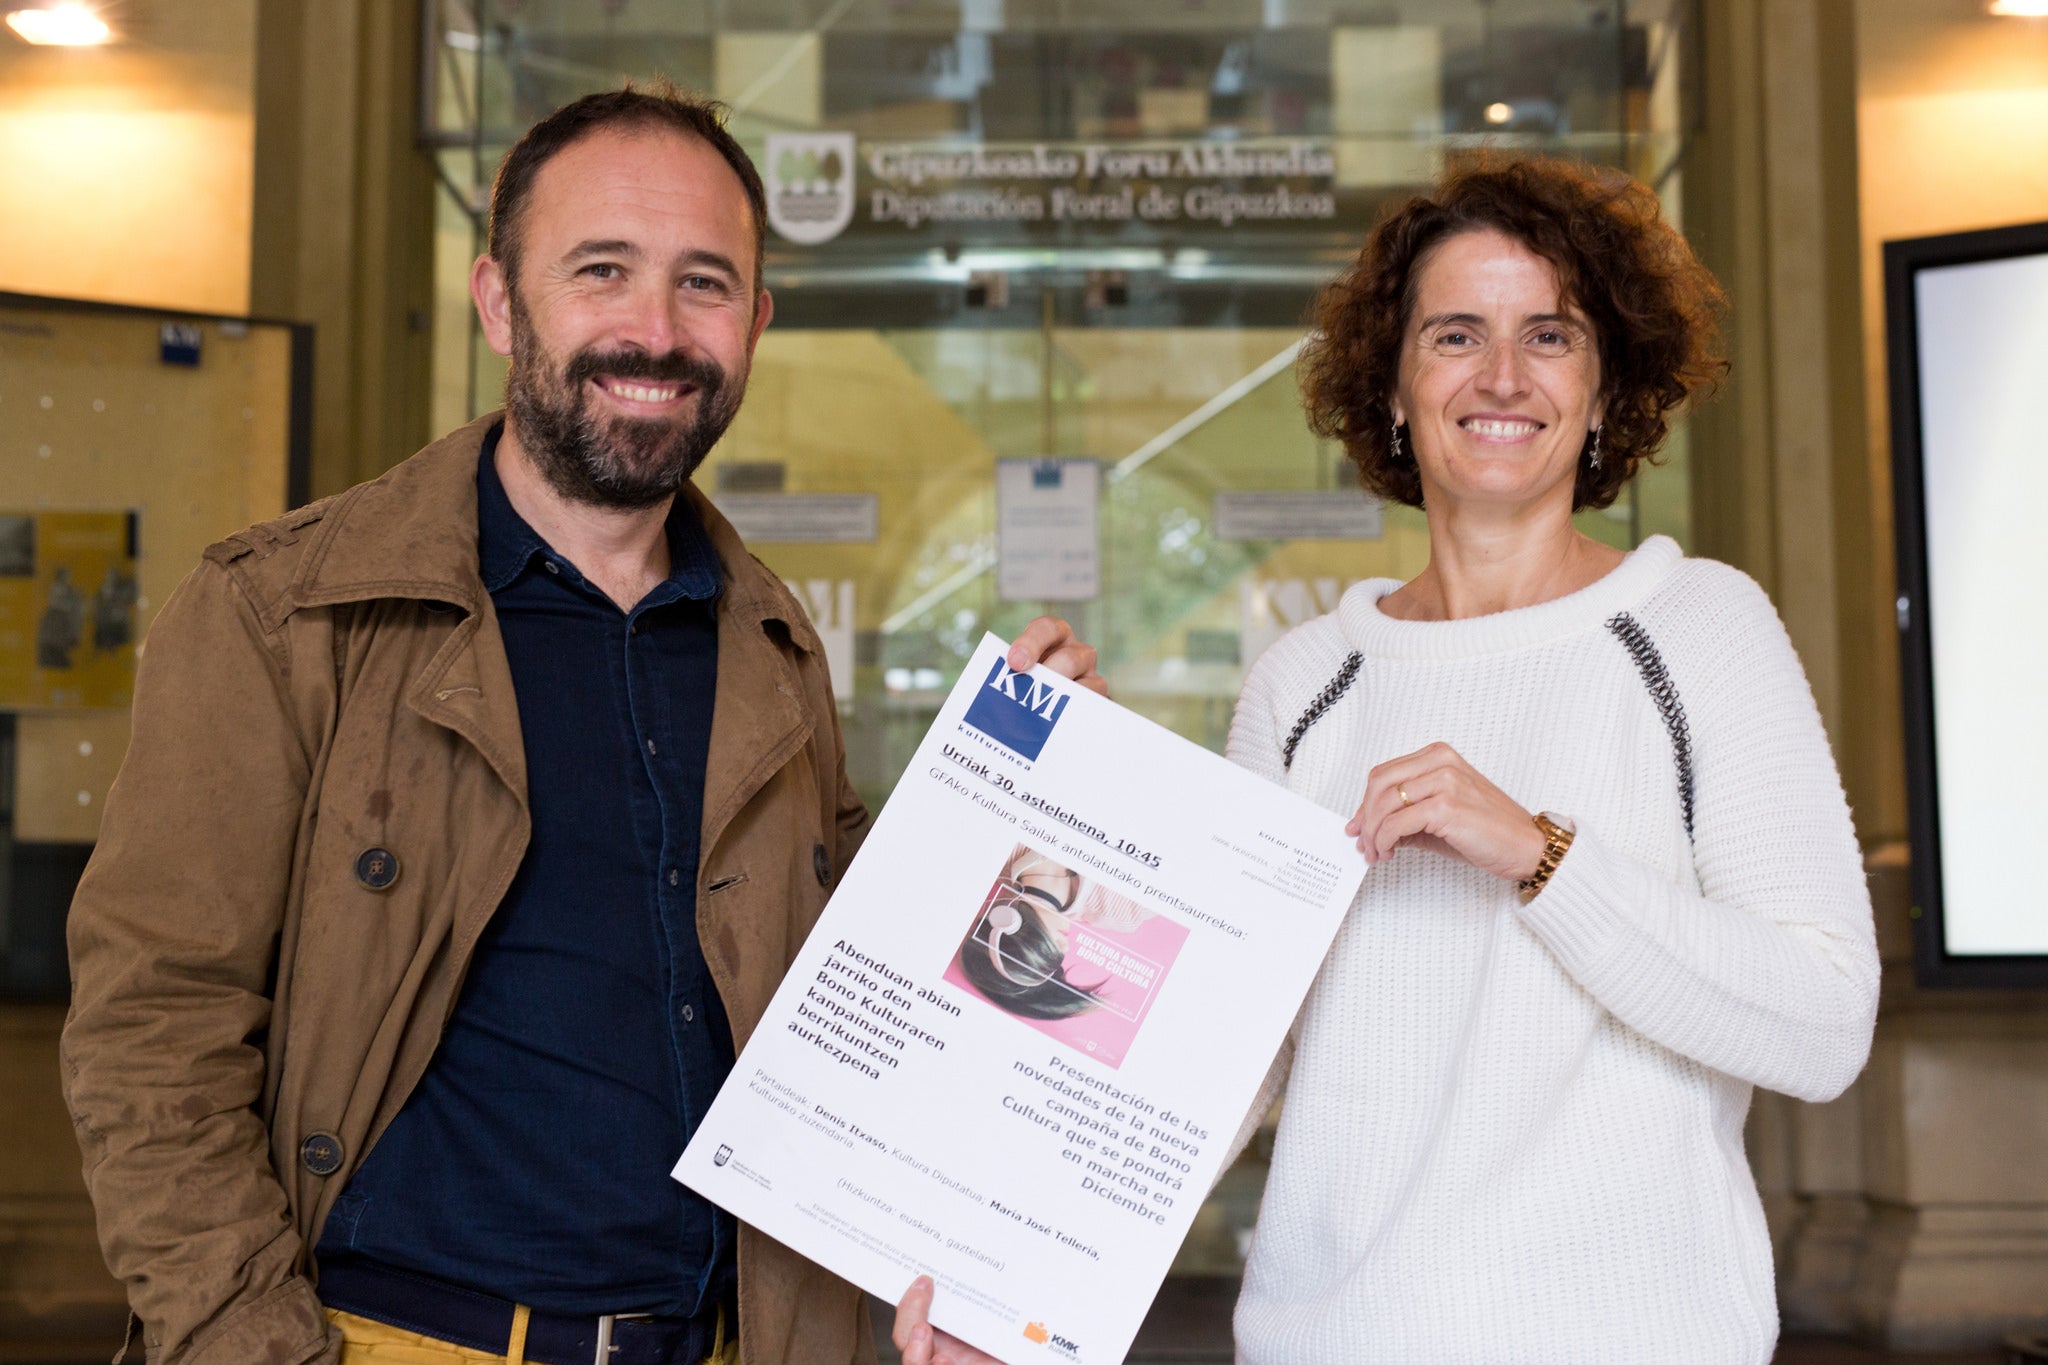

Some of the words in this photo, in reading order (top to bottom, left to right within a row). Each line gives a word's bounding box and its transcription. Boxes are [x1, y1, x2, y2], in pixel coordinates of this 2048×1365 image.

[869, 142, 1078, 182] Gipuzkoako
[1083, 145, 1171, 177] Foru
[1174, 141, 1334, 177] Aldundia
[870, 187, 1045, 228] Diputación
[1050, 186, 1134, 220] Foral
[1137, 187, 1182, 219] de
[1183, 185, 1336, 226] Gipuzkoa
[958, 722, 1032, 771] kulturunea
[942, 743, 989, 778] Urriak
[992, 773, 1015, 795] 30,
[1020, 791, 1108, 844] astelehena,
[1116, 839, 1161, 867] 10:45
[929, 767, 968, 795] GFAko
[971, 791, 1016, 824] Kultura
[1022, 819, 1058, 847] Sailak
[1061, 845, 1141, 888] antolatutako
[1143, 885, 1247, 940] prentsaurrekoa:
[822, 954, 877, 991] jarriko
[881, 988, 911, 1010] den
[833, 939, 913, 990] Abenduan
[916, 987, 960, 1016] abian
[1075, 931, 1122, 962] KULTURA
[1119, 953, 1156, 980] BONUA
[1075, 945, 1106, 968] BONO
[1103, 958, 1151, 990] CULTURA
[797, 1002, 898, 1068] berrikuntzen
[806, 985, 904, 1050] kanpainaren
[815, 970, 856, 1000] Bono
[859, 995, 944, 1050] Kulturaren
[787, 1021, 879, 1079] aurkezpena
[748, 1080, 796, 1115] Kulturako
[797, 1113, 854, 1150] zuzendaria.
[1012, 1060, 1100, 1109] novedades
[1104, 1105, 1125, 1121] de
[1129, 1114, 1144, 1130] la
[1148, 1126, 1199, 1156] nueva
[1048, 1055, 1154, 1115] Presentación
[1158, 1110, 1179, 1126] de
[1183, 1119, 1208, 1139] las
[755, 1068, 811, 1108] Partaideak:
[814, 1104, 845, 1128] Denis
[848, 1124, 887, 1152] Itxaso,
[890, 1147, 929, 1174] Kultura
[931, 1168, 984, 1205] Diputatua;
[989, 1199, 1022, 1221] María
[1025, 1217, 1051, 1233] José
[1055, 1231, 1099, 1261] Tellería,
[1002, 1095, 1061, 1132] Cultura
[1065, 1129, 1096, 1149] que
[1099, 1145, 1119, 1160] se
[1122, 1156, 1182, 1190] pondrá
[1045, 1099, 1119, 1139] campaña
[1123, 1135, 1144, 1151] de
[1148, 1145, 1190, 1173] Bono
[1061, 1148, 1082, 1164] en
[1086, 1160, 1148, 1195] marcha
[1152, 1192, 1173, 1207] en
[1080, 1176, 1165, 1225] Diciembre
[836, 1177, 896, 1213] (Hizkuntza:
[898, 1212, 942, 1242] euskara,
[945, 1237, 1005, 1272] gaztelania)
[1050, 1333, 1079, 1354] KMK
